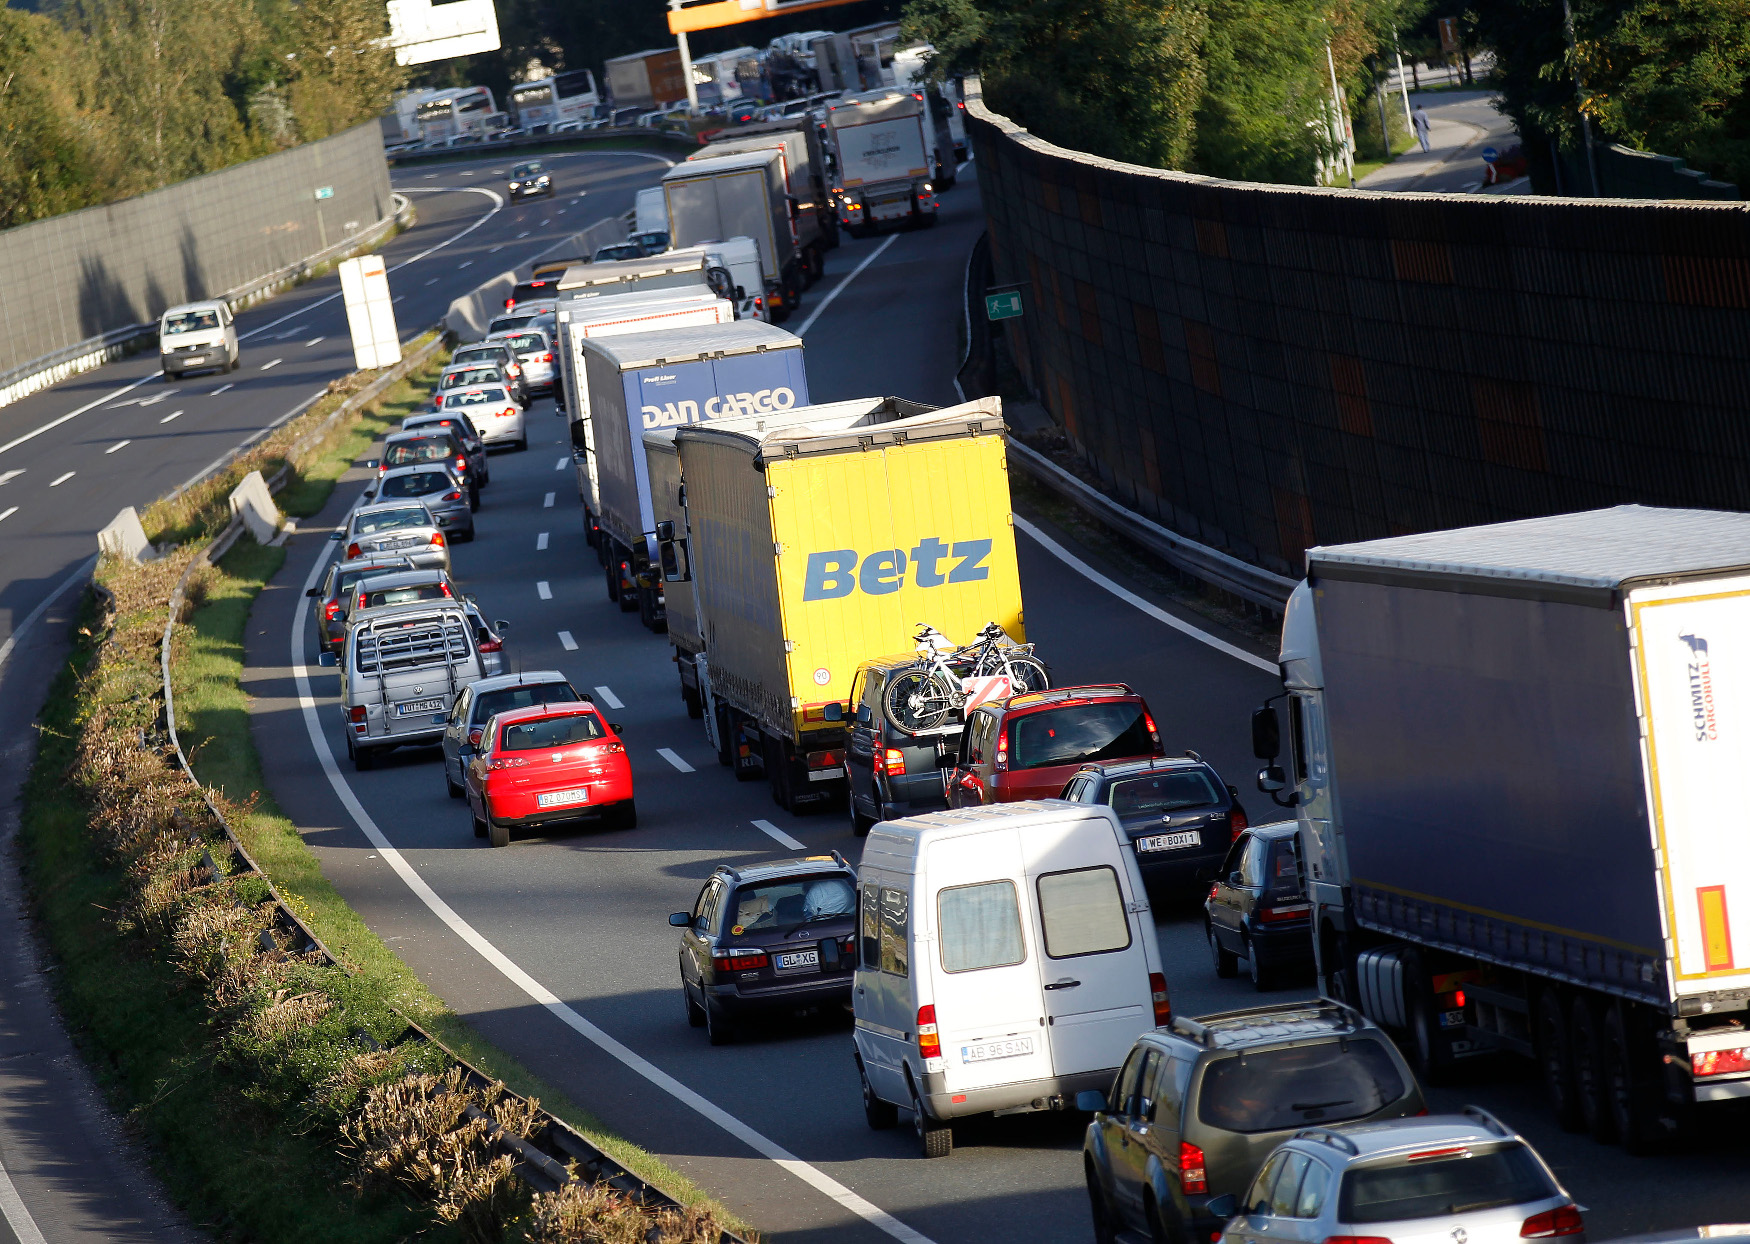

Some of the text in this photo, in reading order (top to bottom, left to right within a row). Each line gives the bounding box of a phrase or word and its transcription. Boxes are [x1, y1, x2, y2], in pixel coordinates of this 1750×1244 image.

[643, 376, 660, 384] Profi
[641, 387, 796, 429] DAN CARGO
[803, 537, 993, 602] Betz
[816, 671, 827, 680] 90
[403, 704, 415, 712] TUT
[429, 700, 441, 708] 412
[1688, 662, 1708, 742] SCHMITZ
[1700, 661, 1718, 741] CARGOBULL
[1149, 839, 1162, 848] WE
[1189, 834, 1194, 843] 1
[782, 952, 816, 967] GL XG
[971, 1047, 985, 1059] AB
[1005, 1041, 1029, 1054] SAN
